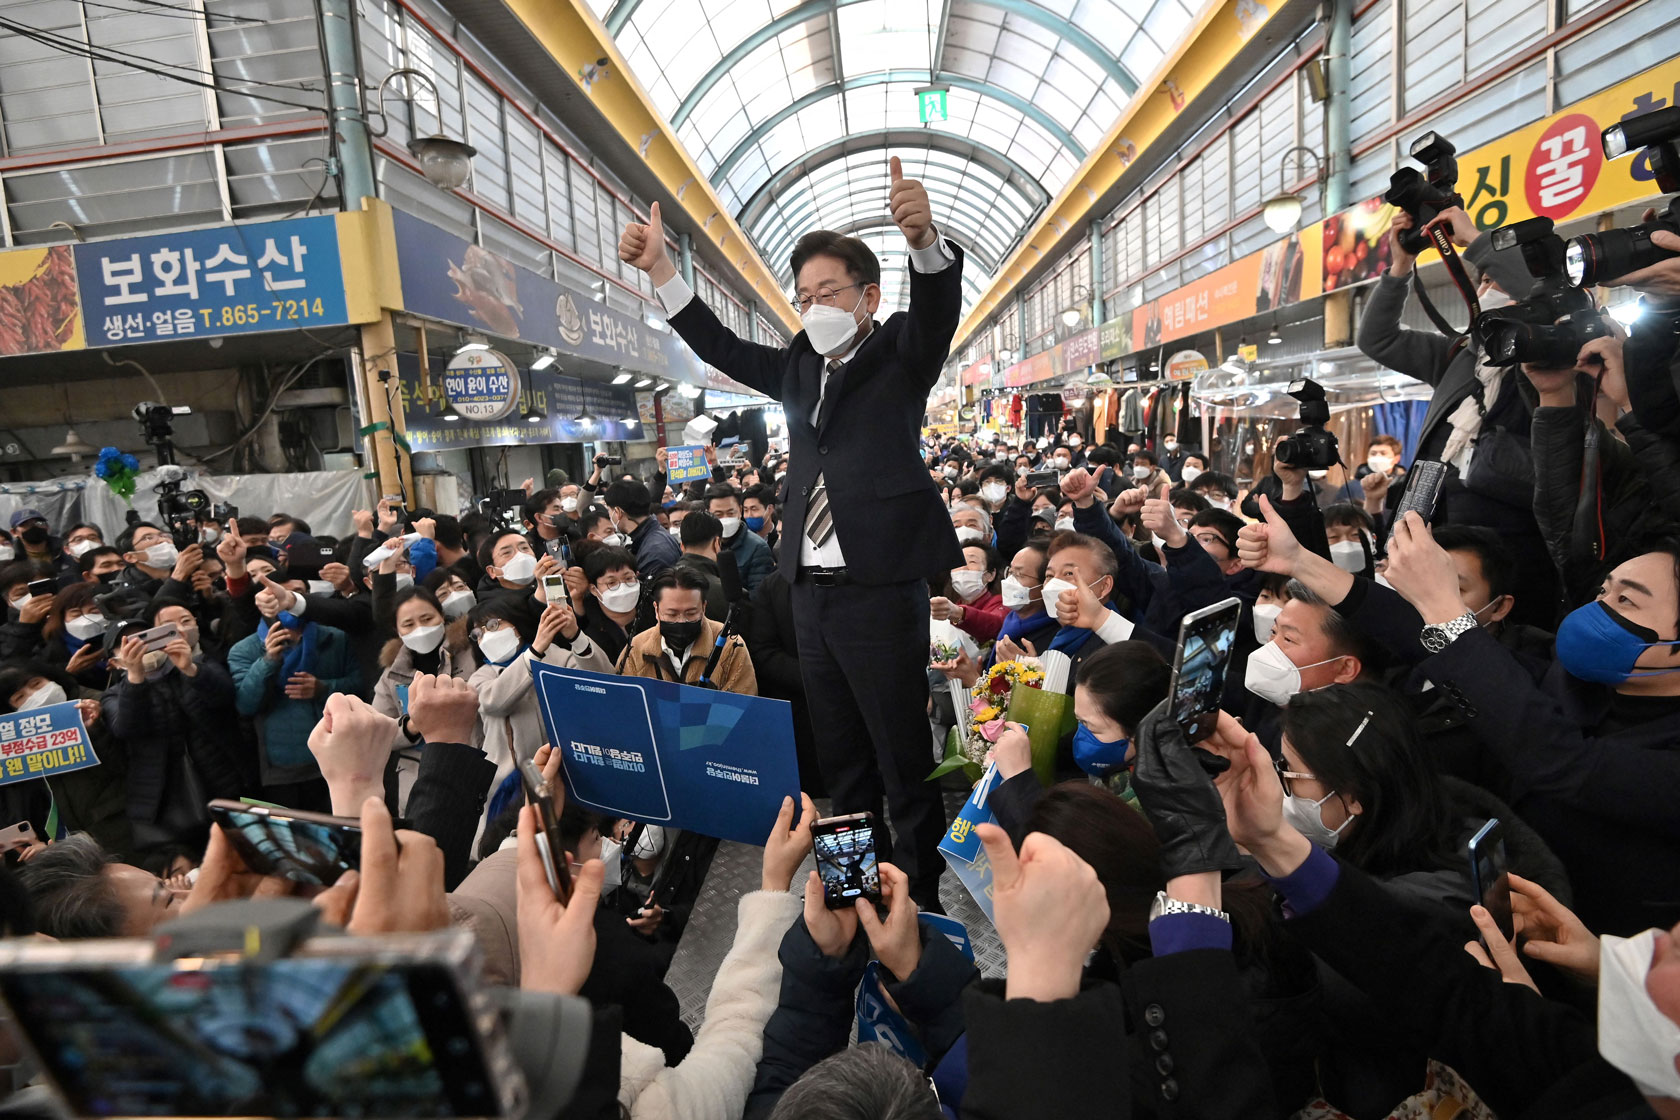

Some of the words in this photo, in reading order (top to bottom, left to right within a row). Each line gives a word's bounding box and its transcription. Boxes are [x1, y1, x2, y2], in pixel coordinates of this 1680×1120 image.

[1536, 125, 1591, 208] 꿀
[1434, 229, 1452, 256] Canon
[101, 235, 308, 306] 보화수산
[103, 308, 196, 340] 생선·얼음
[199, 297, 324, 328] T.865-7214
[589, 308, 639, 358] 보화수산
[489, 375, 508, 393] 수산
[466, 405, 494, 415] NO.13
[18, 713, 53, 737] 장모
[1, 735, 48, 757] 부정수급
[50, 728, 79, 747] 23억
[570, 740, 603, 757] 됩니다
[602, 747, 643, 763] 민주당이
[26, 744, 87, 773] 말이냐!!
[573, 751, 605, 766] 합니다
[706, 767, 760, 785] 더불어민주당
